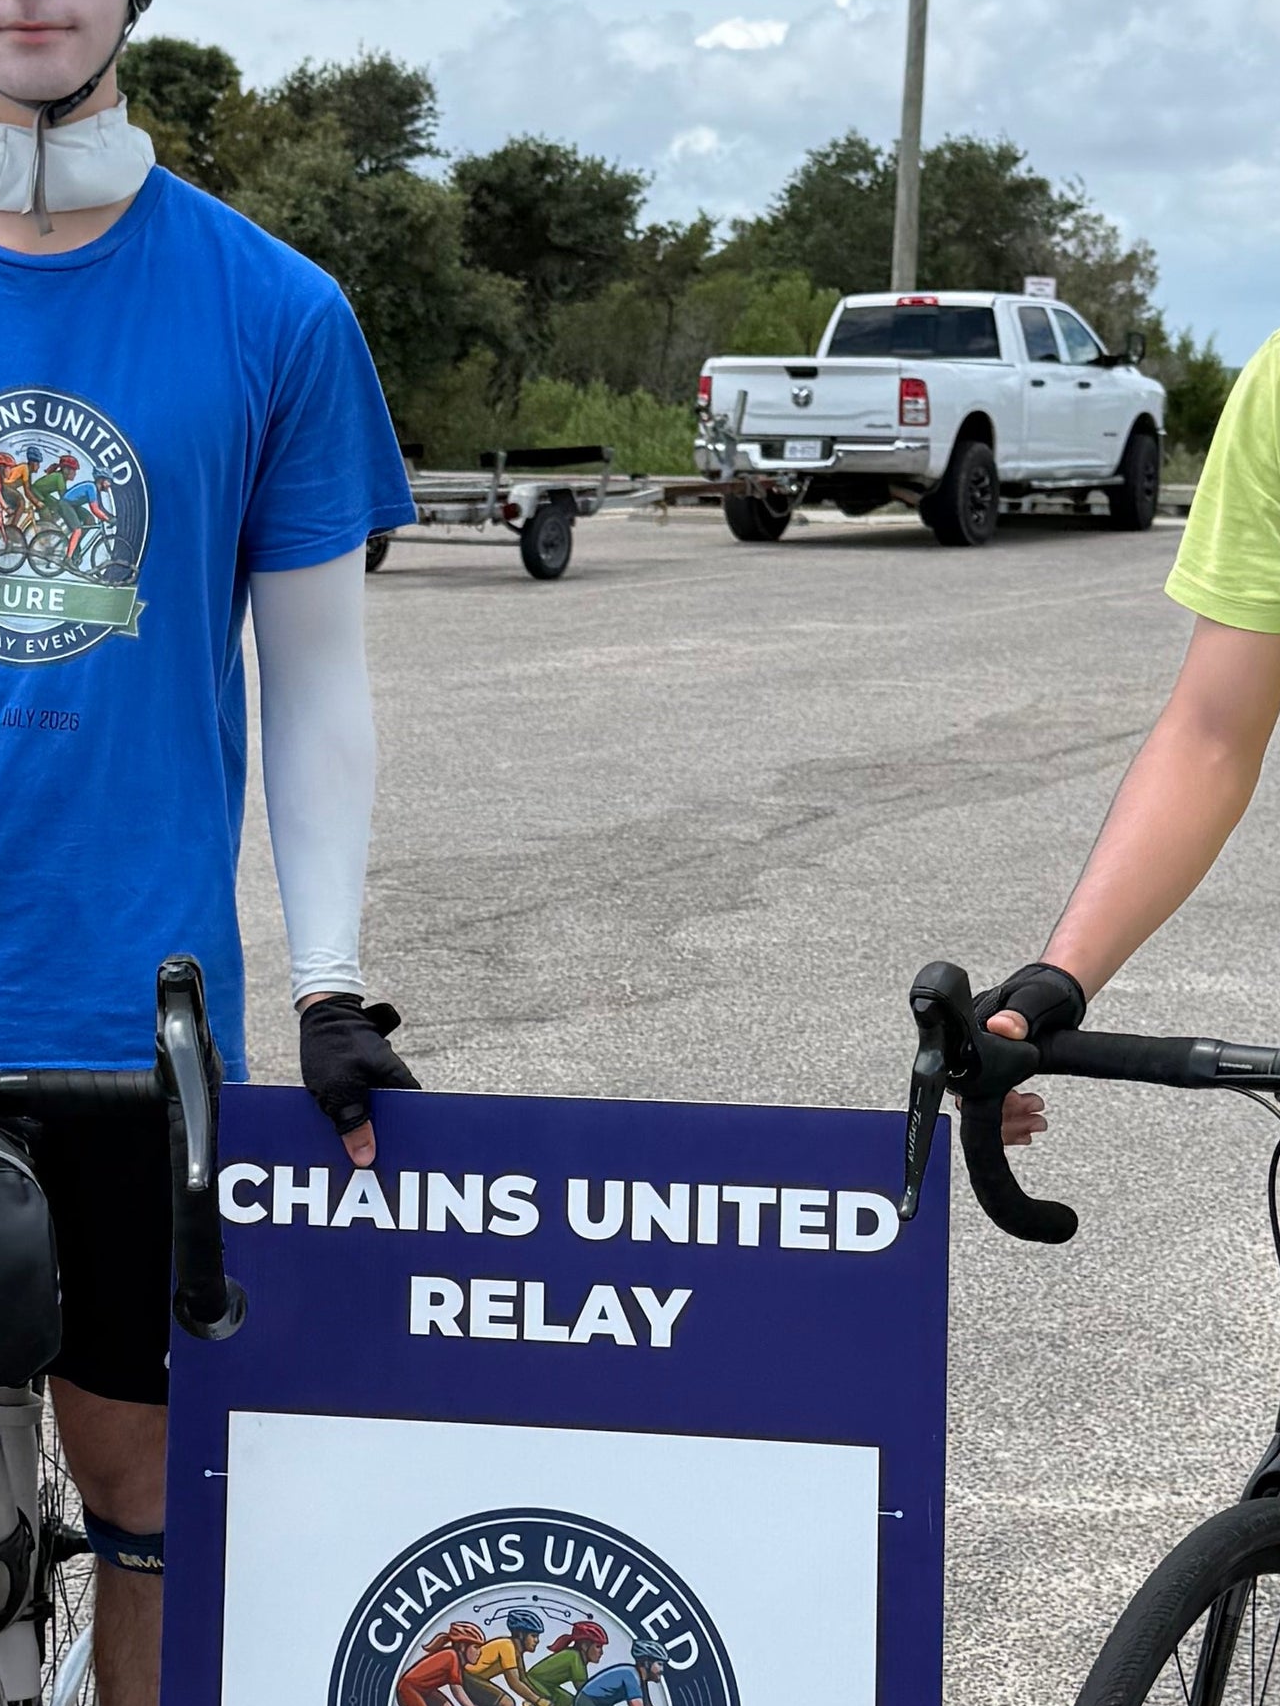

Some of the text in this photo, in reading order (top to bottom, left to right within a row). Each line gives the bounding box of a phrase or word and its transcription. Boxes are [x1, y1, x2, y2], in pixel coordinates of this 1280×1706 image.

[45, 402, 133, 486] UNITED
[25, 623, 88, 654] EVENT
[2, 708, 35, 729] JULY
[38, 710, 80, 731] 2026
[218, 1162, 900, 1252] CHAINS UNITED
[409, 1275, 693, 1348] RELAY
[367, 1532, 700, 1672] CHAINS UNITED
